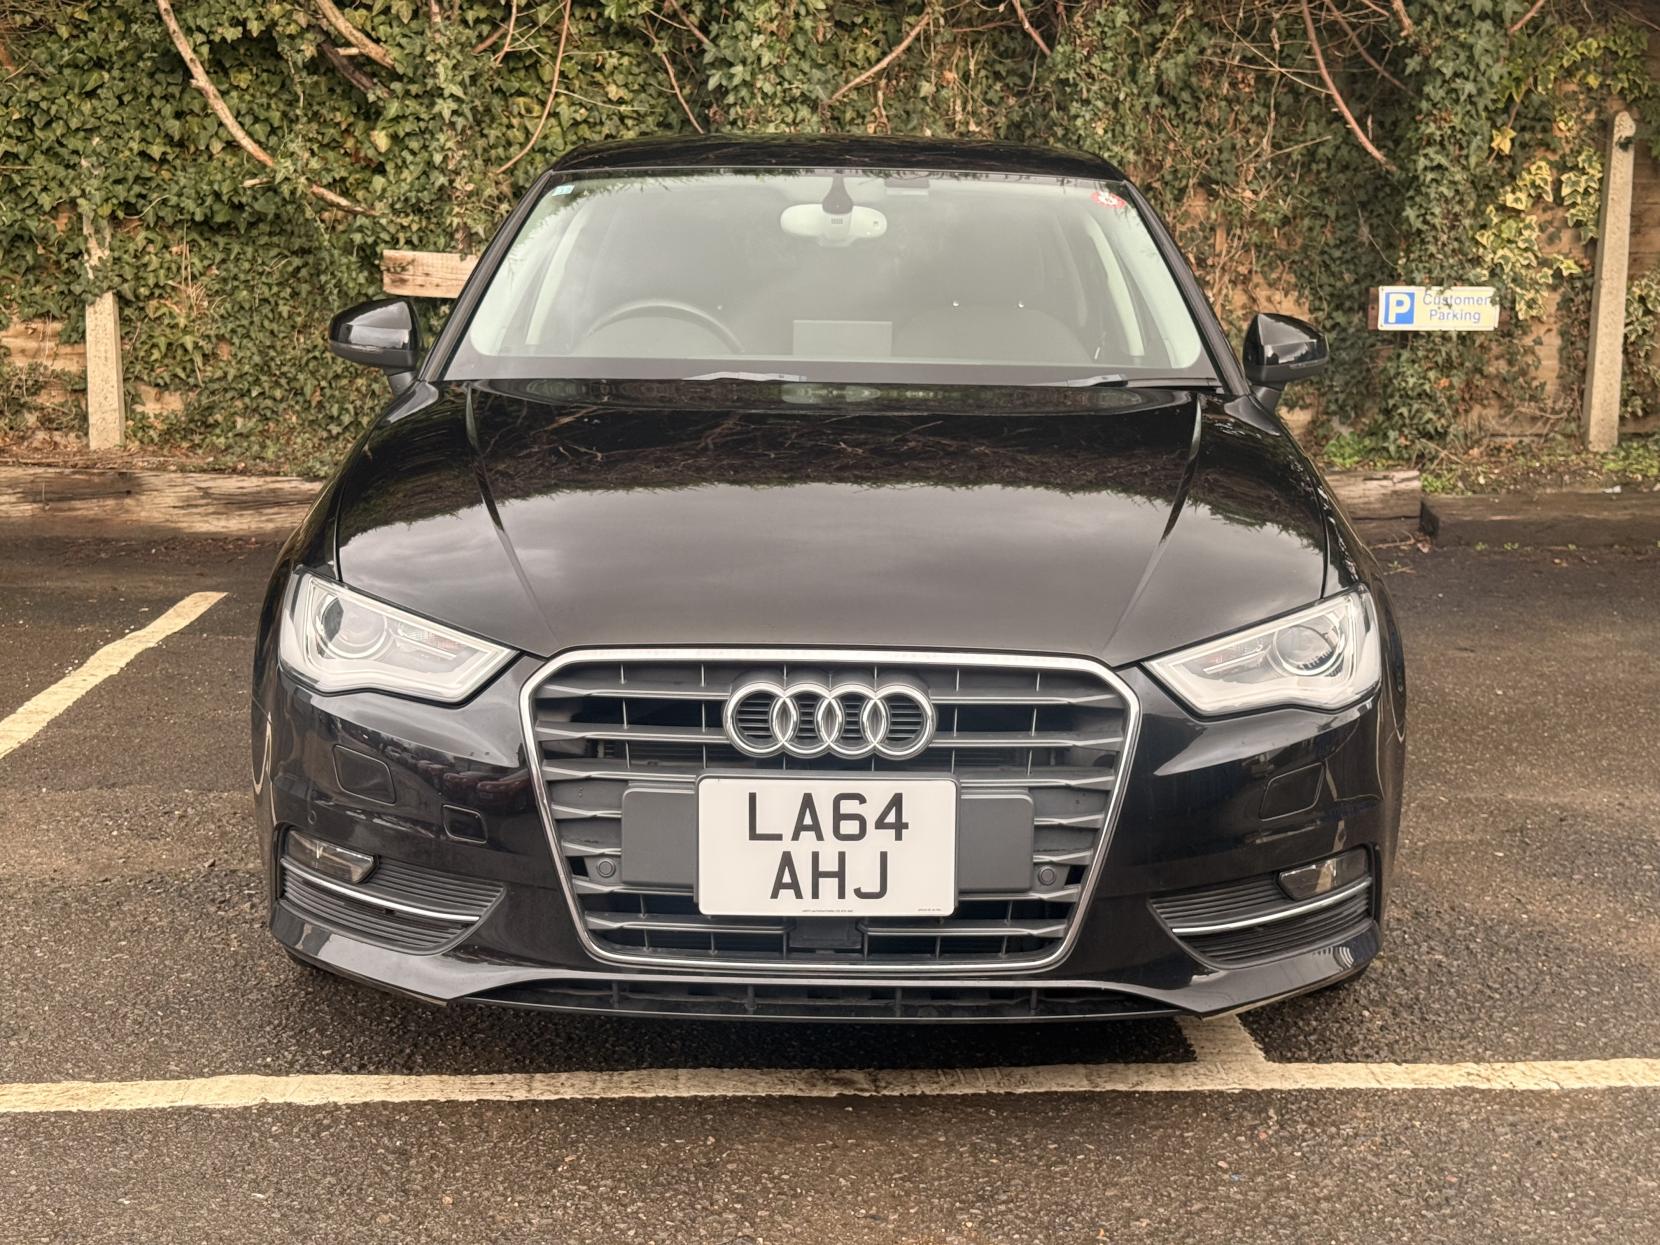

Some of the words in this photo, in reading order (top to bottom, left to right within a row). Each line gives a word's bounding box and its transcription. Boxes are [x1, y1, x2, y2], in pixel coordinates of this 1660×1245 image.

[1388, 293, 1411, 323] P
[1423, 293, 1490, 306] Customer
[1429, 309, 1481, 323] Parking
[748, 792, 909, 841] LA64
[770, 851, 888, 899] AHJ
